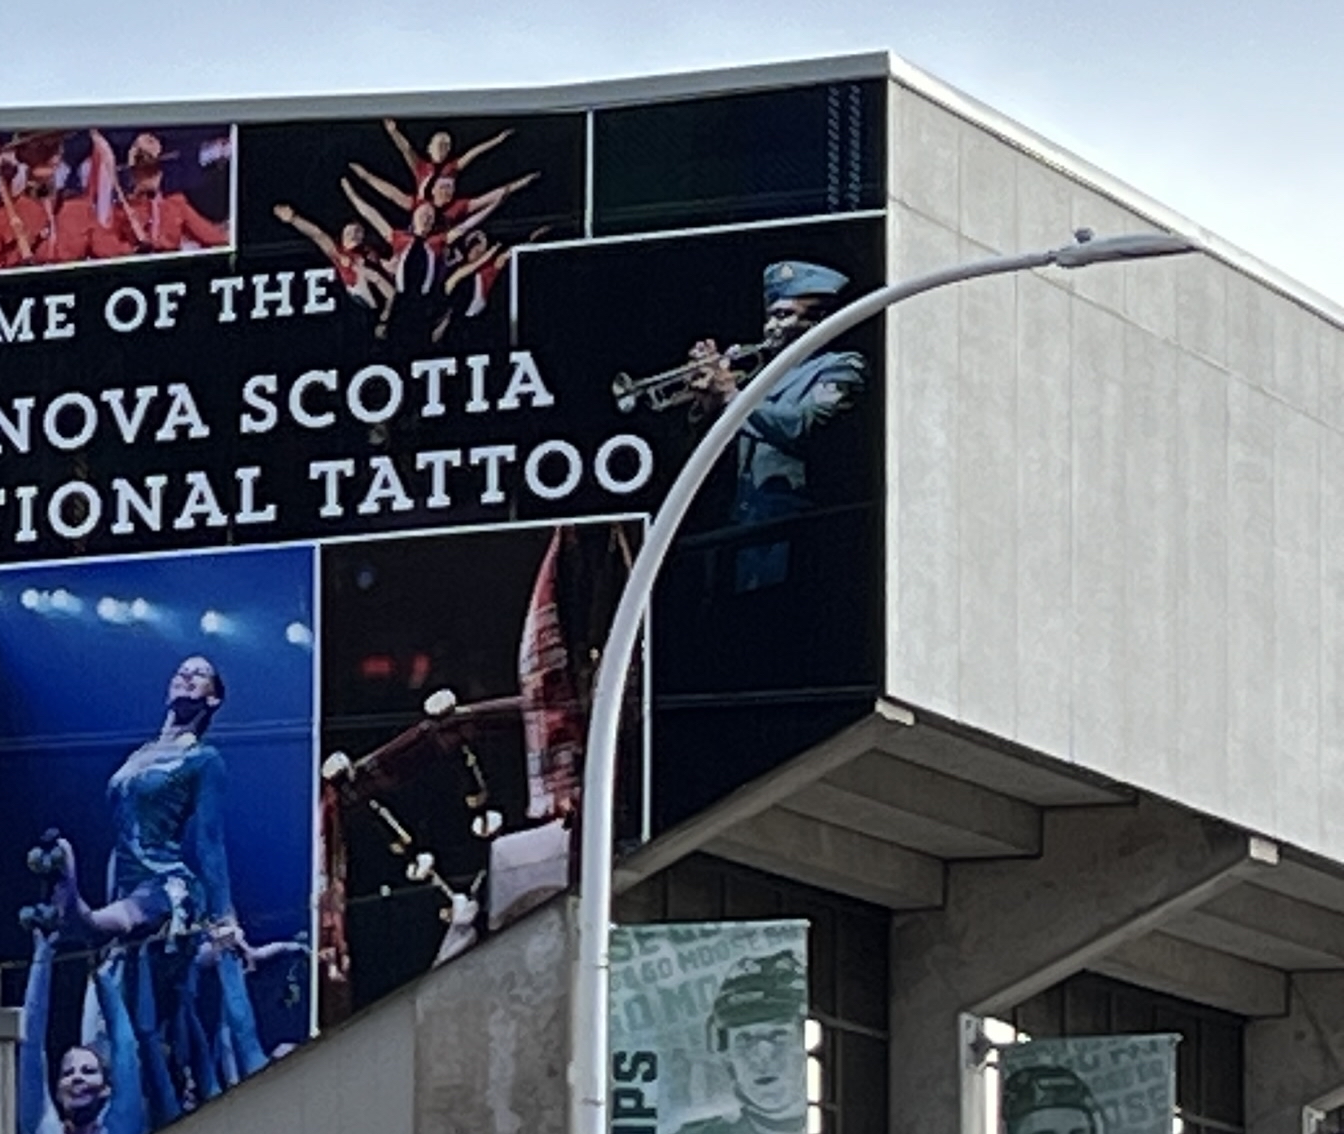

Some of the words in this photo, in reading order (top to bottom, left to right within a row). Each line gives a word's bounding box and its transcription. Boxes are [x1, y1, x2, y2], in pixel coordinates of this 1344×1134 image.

[104, 282, 187, 332] OF
[211, 268, 337, 323] THE
[239, 350, 554, 434] SCOTIA
[309, 433, 654, 518] TATTOO
